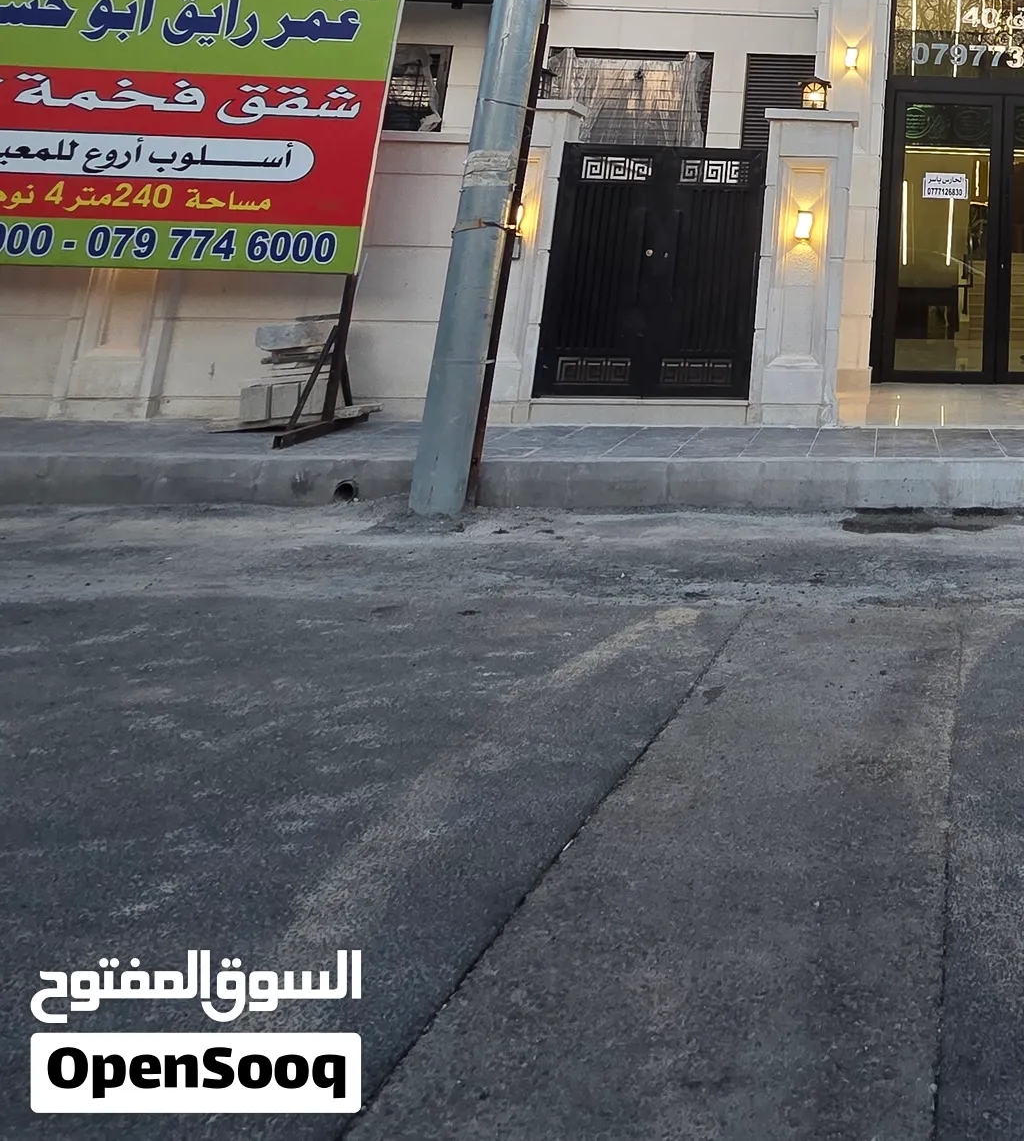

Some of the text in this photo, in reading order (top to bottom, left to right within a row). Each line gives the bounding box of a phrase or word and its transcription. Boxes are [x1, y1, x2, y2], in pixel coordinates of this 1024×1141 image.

[263, 8, 362, 50] عمر
[962, 6, 999, 29] 40
[14, 72, 362, 125] شقق فخمة
[82, 137, 144, 173] أروع
[149, 144, 293, 173] أسلوب
[185, 189, 272, 212] مساحة
[86, 225, 158, 259] 079
[168, 227, 237, 262] 774
[245, 229, 337, 265] 6000
